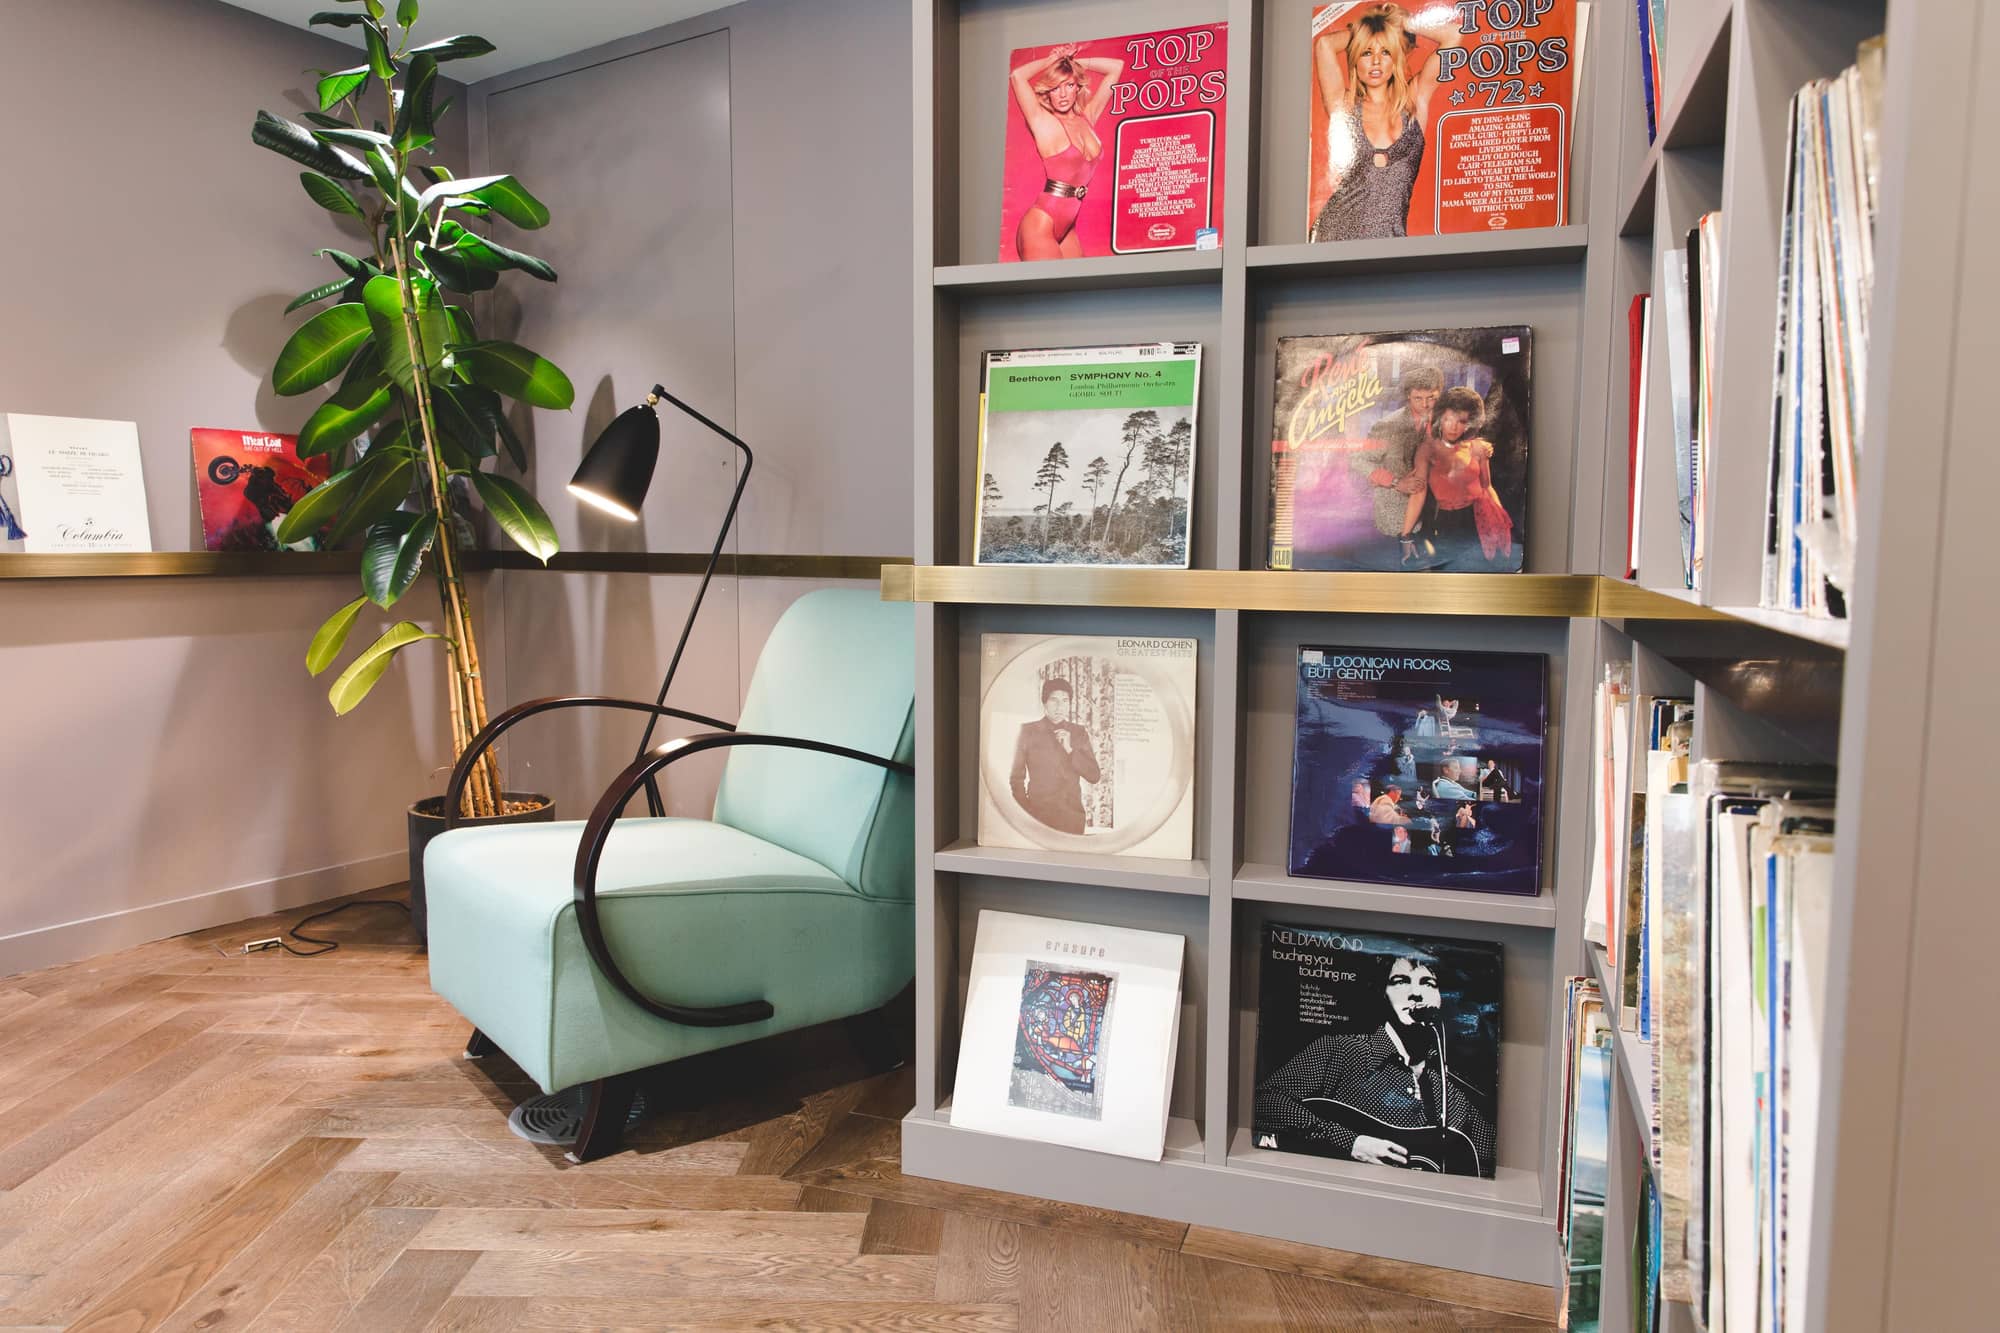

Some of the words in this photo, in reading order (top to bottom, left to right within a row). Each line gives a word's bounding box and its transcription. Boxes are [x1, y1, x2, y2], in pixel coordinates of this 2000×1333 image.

[1455, 0, 1553, 34] TOP
[1480, 32, 1497, 42] OF
[1500, 30, 1526, 41] THE
[1127, 31, 1214, 70] TOP
[1437, 37, 1568, 82] POPS
[1150, 68, 1164, 77] OF
[1167, 66, 1190, 76] THE
[1111, 71, 1226, 115] POPS
[1467, 80, 1526, 107] '72
[1470, 123, 1503, 132] AMAZING
[1505, 121, 1531, 130] GRACE
[1471, 117, 1482, 125] MY
[1452, 133, 1476, 141] METAL
[1528, 127, 1548, 135] LOVE
[1450, 141, 1470, 149] LONG
[1472, 139, 1500, 147] HAIRED
[1502, 136, 1528, 145] LOVER
[1529, 135, 1551, 143] FROM
[1479, 144, 1521, 154] LIVERPOOL
[1460, 154, 1492, 162] MOULDY
[1493, 152, 1509, 160] OLD
[1511, 150, 1539, 159] DOUGH
[1454, 177, 1472, 185] LIKE
[1484, 175, 1509, 183] TEACH
[1528, 172, 1556, 180] WORLD
[1464, 169, 1480, 177] YOU
[1480, 168, 1503, 176] WEAR
[1504, 188, 1533, 196] FATHER
[1442, 199, 1464, 207] MAMA
[1465, 198, 1488, 206] WEER
[1489, 197, 1503, 205] ALL
[1504, 195, 1535, 204] CRAZEE
[1536, 194, 1555, 202] NOW
[1472, 204, 1509, 213] WITHOUT
[1510, 203, 1525, 211] YOU
[1139, 347, 1154, 356] MONO
[1009, 374, 1061, 383] Beethoven
[1070, 371, 1131, 381] SYMPHONY
[1135, 370, 1151, 378] No.
[1070, 383, 1095, 391] London
[1097, 381, 1140, 389] Philharmonic
[1288, 372, 1384, 449] Angela
[242, 434, 264, 446] Meat
[263, 437, 282, 448] Loaf
[57, 524, 124, 541] Columbia
[1117, 639, 1160, 649] LEONARD
[1161, 641, 1192, 649] COHEN
[1117, 648, 1168, 657] GREATEST
[1169, 650, 1193, 658] HITS
[1333, 656, 1400, 669] DOONICAN
[1403, 658, 1452, 672] ROCKS,
[1308, 667, 1333, 679] BUT
[1337, 668, 1385, 680] GENTLY
[1271, 930, 1296, 945] NEIL
[1297, 932, 1363, 951] DIAMOND
[1045, 940, 1106, 958] erasure
[1272, 947, 1313, 965] touching
[1313, 956, 1333, 965] you
[1299, 963, 1340, 982] touching
[1340, 972, 1357, 981] me
